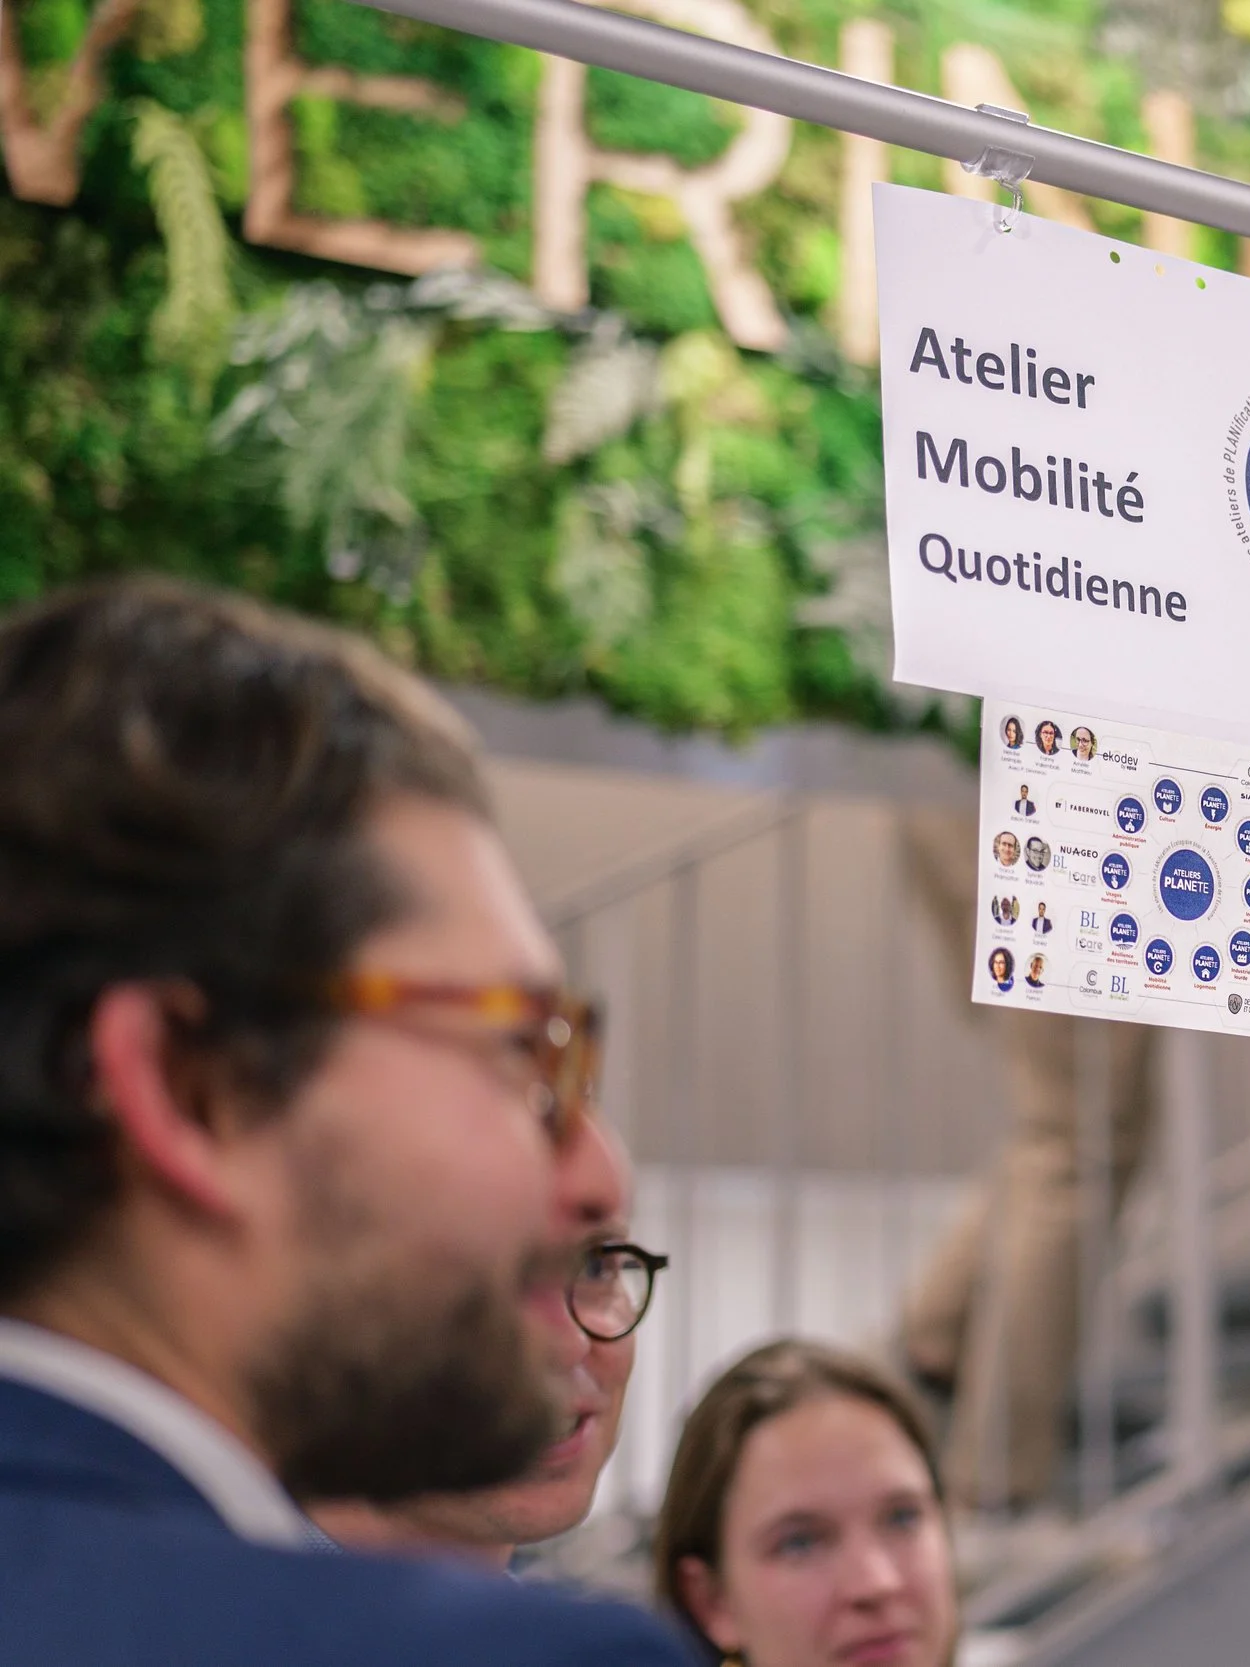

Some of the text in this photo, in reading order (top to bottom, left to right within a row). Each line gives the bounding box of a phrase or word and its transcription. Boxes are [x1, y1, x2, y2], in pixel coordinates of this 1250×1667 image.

[909, 326, 1096, 409] Atelier
[915, 430, 1145, 523] Mobilité
[1223, 466, 1235, 485] de
[1227, 488, 1250, 545] ateliers
[918, 532, 1187, 622] Quotidienne
[1102, 751, 1138, 766] ekodev
[1156, 792, 1179, 802] PLANETE
[1070, 804, 1110, 817] FABERNOVEL
[1203, 800, 1226, 810] PLANETE
[1119, 811, 1142, 821] PLANETE
[1112, 834, 1147, 843] Administration
[1060, 846, 1099, 858] NUAGEO
[1053, 855, 1067, 869] BL
[1104, 866, 1127, 876] PLANETE
[1173, 869, 1201, 880] ATELIERS
[1164, 876, 1209, 894] PLANETE
[1080, 911, 1099, 929] BL
[1112, 927, 1136, 937] PLANETE
[1147, 952, 1170, 962] PLANETE
[1195, 959, 1218, 969] PLANETE
[1111, 975, 1130, 994] BL
[1193, 983, 1217, 991] Logement
